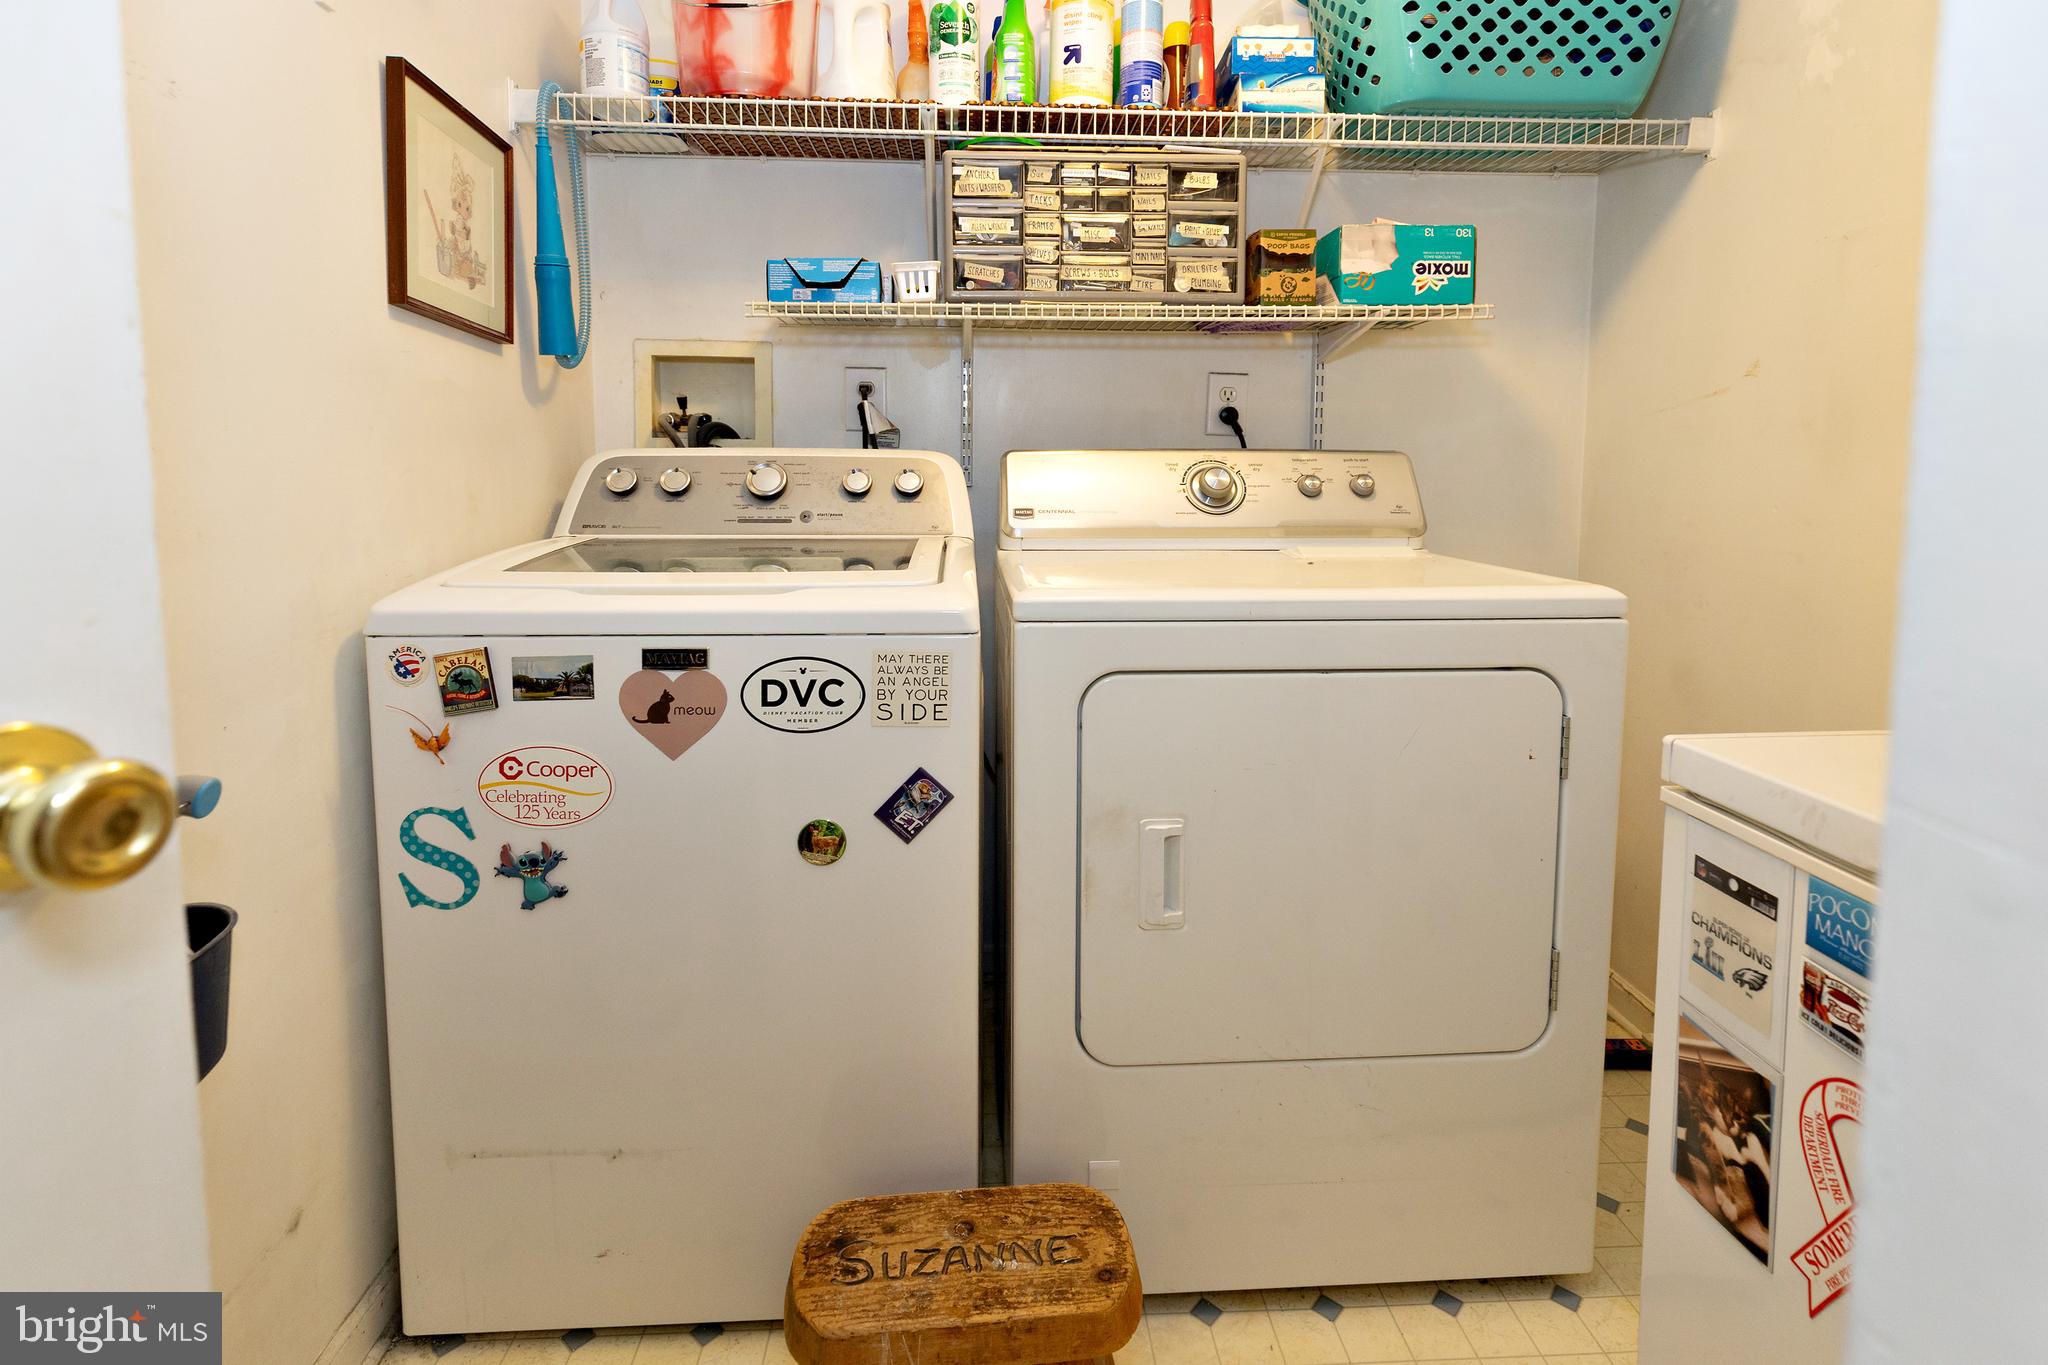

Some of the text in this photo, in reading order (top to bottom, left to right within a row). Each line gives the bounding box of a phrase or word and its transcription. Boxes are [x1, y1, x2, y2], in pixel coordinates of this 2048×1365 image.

[964, 170, 996, 180] ANCHORS
[1140, 172, 1162, 181] NAILS
[1189, 174, 1210, 184] BULBS
[1029, 194, 1052, 206] TACKS
[1137, 198, 1157, 206] NAILS
[1028, 221, 1054, 232] FRAMES
[1148, 224, 1165, 232] NAILS
[1424, 228, 1434, 237] 13
[1456, 228, 1472, 238] 130
[1150, 252, 1166, 261] NAILS
[967, 266, 1000, 278] SCRATCHES
[1064, 268, 1091, 277] SCREWS
[1098, 268, 1120, 278] BOLTS
[1182, 264, 1218, 274] DRILL BITS
[1415, 262, 1468, 276] moxie
[1031, 279, 1052, 289] HOOKS
[1190, 278, 1222, 289] PLUMBING
[388, 646, 426, 662] AMERICA
[646, 653, 704, 664] MAYTAG
[878, 654, 948, 664] MAY THERE
[438, 656, 486, 678] CABELA'S
[878, 666, 948, 675] ALWAYS BE
[877, 676, 948, 686] AN ANGEL
[761, 678, 845, 708] DVC
[876, 688, 948, 700] BY YOUR
[674, 706, 716, 716] meow
[876, 704, 948, 720] SIDE
[526, 760, 598, 782] Cooper
[485, 790, 566, 806] Celebrating
[515, 804, 581, 820] 125 Years
[398, 806, 480, 910] S
[1692, 911, 1773, 970] CHAMPIONS
[1804, 1114, 1828, 1193] DEPARTMENT
[1814, 1110, 1846, 1205] SOMERDALE FIRE
[830, 1234, 1084, 1286] SUZANNE
